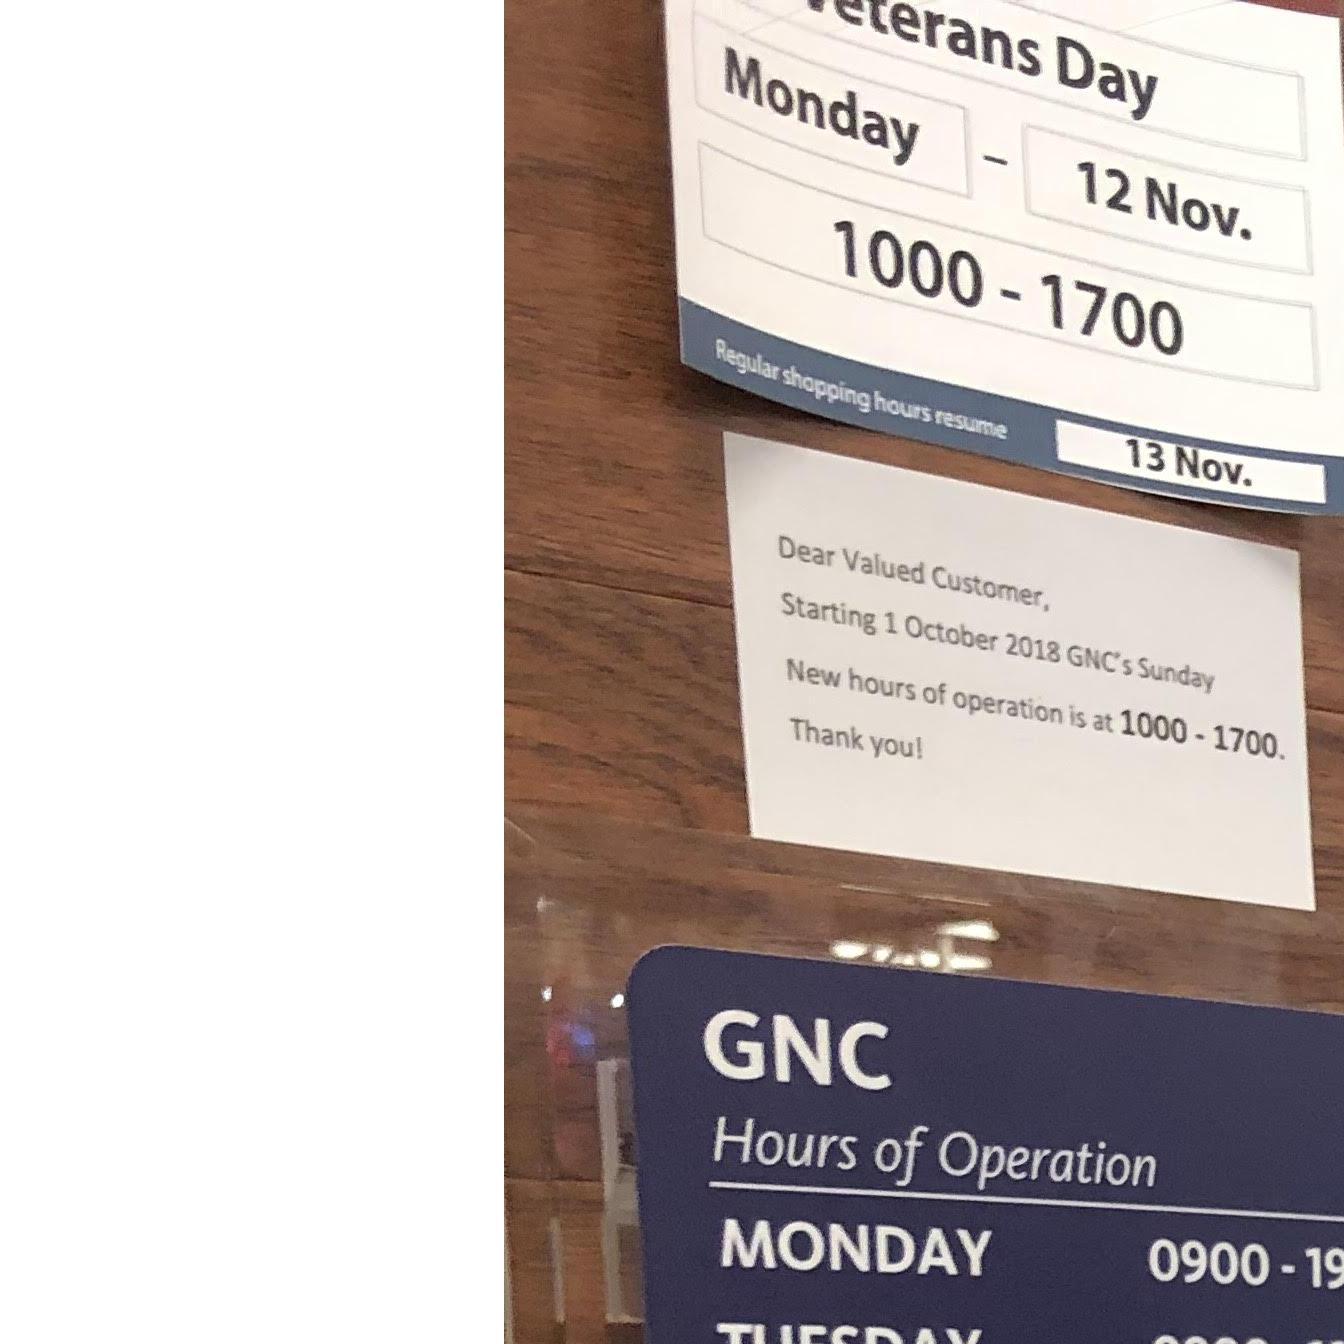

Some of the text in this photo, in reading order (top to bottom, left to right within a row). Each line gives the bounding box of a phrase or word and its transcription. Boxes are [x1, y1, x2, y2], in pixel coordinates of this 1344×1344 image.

[807, 0, 1159, 121] eterans Day
[724, 47, 920, 166] Monday
[1077, 161, 1133, 214] 12
[1145, 177, 1252, 241] Nov.
[833, 220, 983, 308] 1000
[1041, 274, 1183, 356] 1700
[715, 338, 1008, 440] Regular shopping hours resume
[1126, 438, 1252, 487] 13 Nov.
[778, 535, 1050, 612] Dear Valued Customer,
[781, 592, 877, 636] Starting
[884, 611, 898, 635] 1
[904, 615, 999, 651] October
[1005, 633, 1061, 663] 2018
[1137, 657, 1215, 695] Sunday
[786, 658, 841, 688] New
[848, 667, 917, 701] hours
[922, 682, 947, 705] of
[952, 691, 1063, 724] operation
[1069, 705, 1088, 729] is
[1093, 713, 1114, 733] at
[1120, 709, 1188, 744] 1000
[1213, 725, 1285, 760] 1700.
[789, 717, 923, 760] Thank you!
[703, 1009, 892, 1091] GNC
[713, 1116, 1157, 1191] Hours of Operation
[721, 1218, 992, 1277] MONDAY
[1149, 1238, 1270, 1286] 0900
